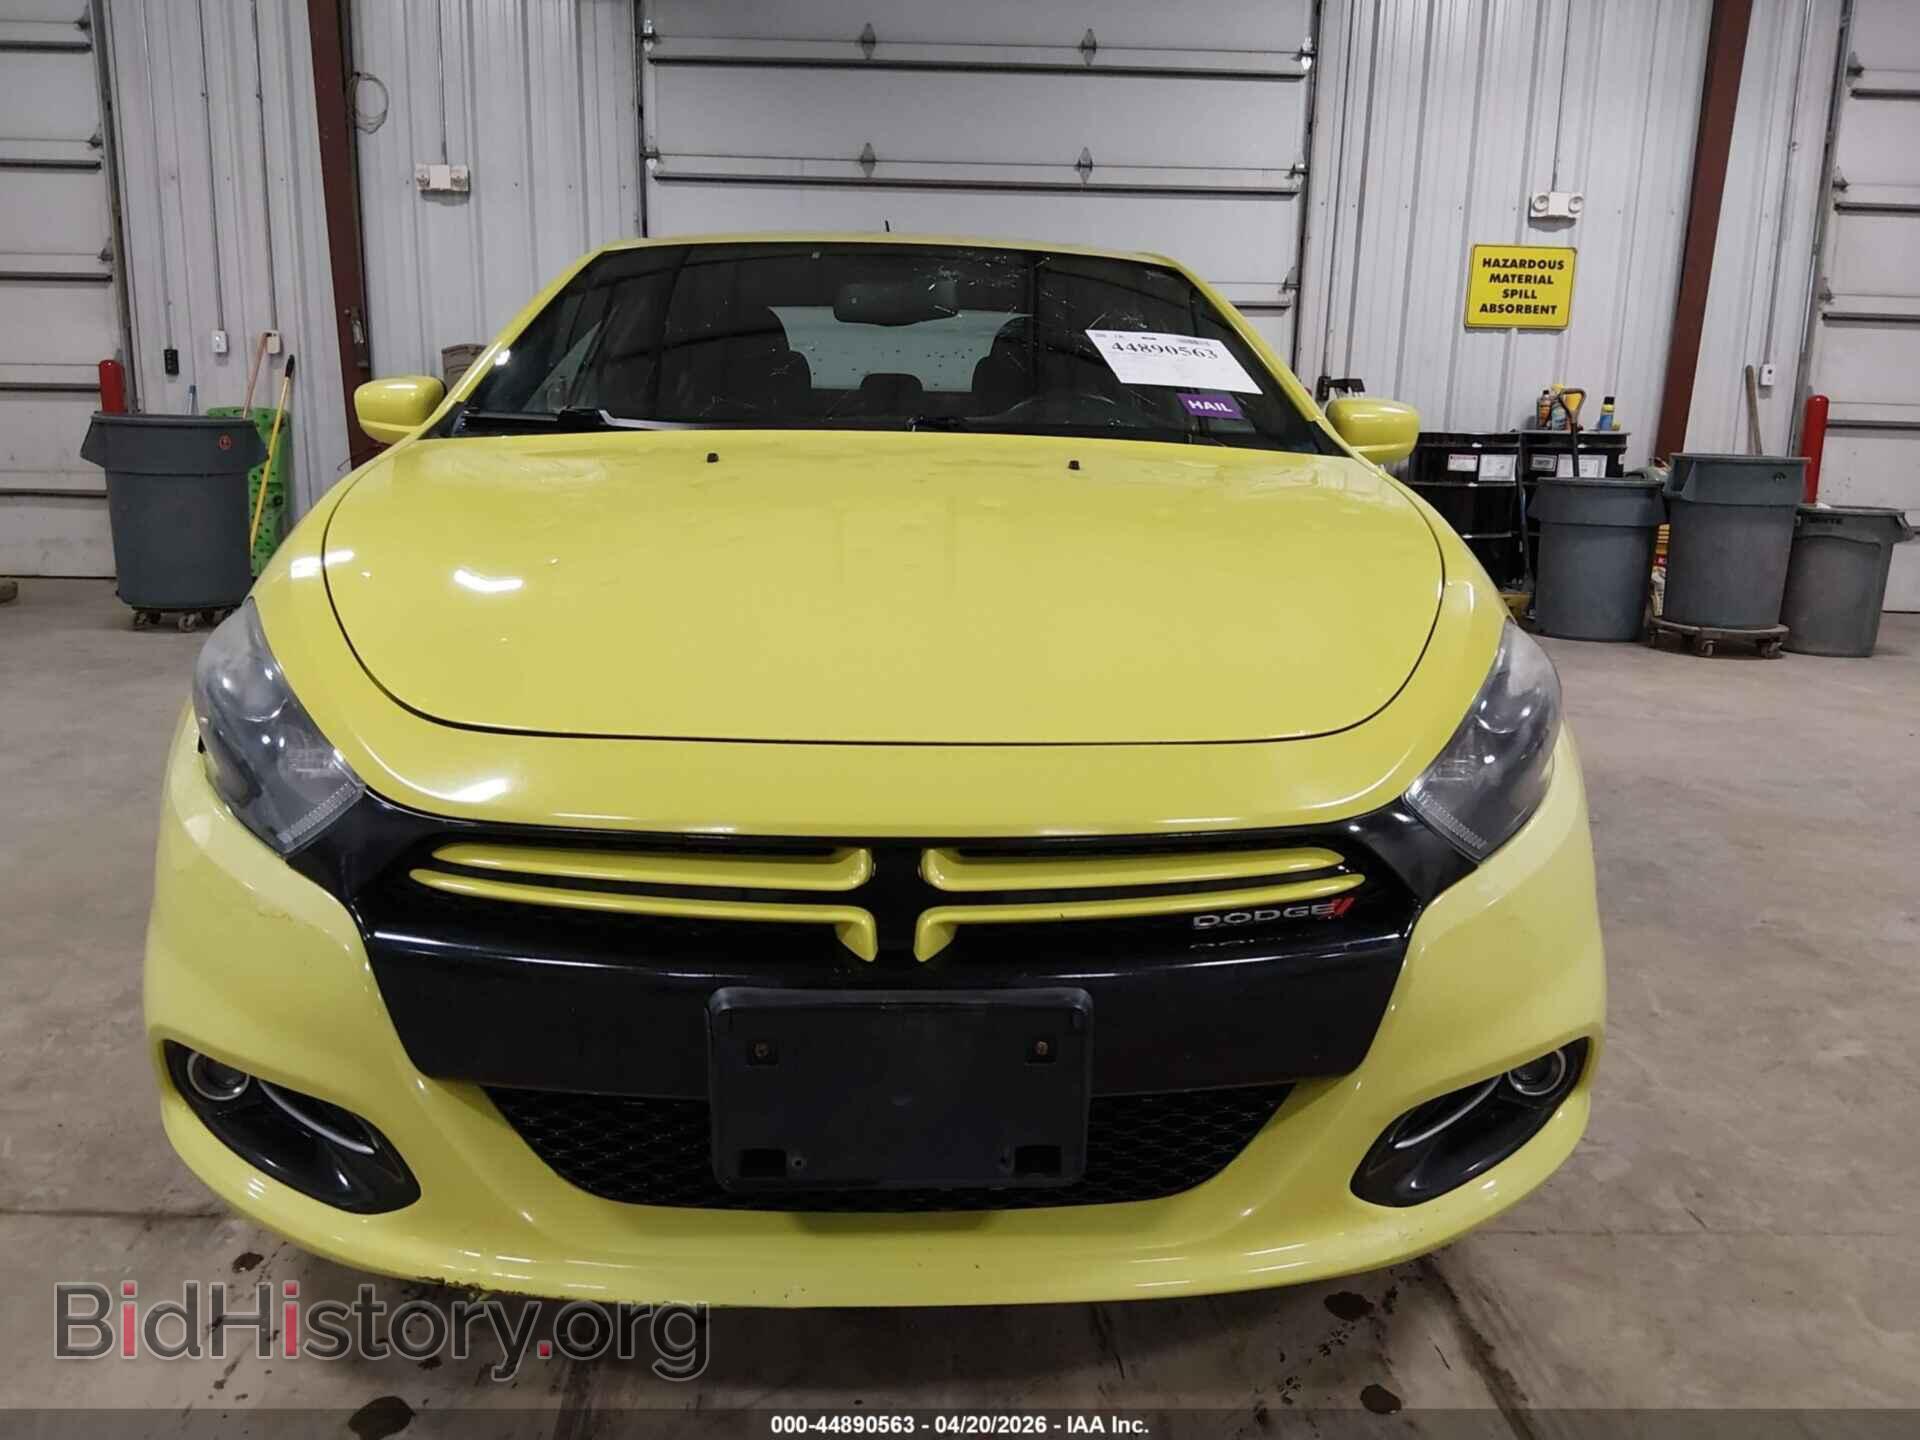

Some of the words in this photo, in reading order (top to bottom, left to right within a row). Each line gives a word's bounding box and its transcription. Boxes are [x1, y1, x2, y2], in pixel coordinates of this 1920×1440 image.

[1482, 258, 1565, 270] HAZARDOUS
[1489, 273, 1554, 285] MATERIAL
[1502, 289, 1537, 299] SPILL
[1479, 303, 1557, 314] ABSORBENT
[1111, 341, 1219, 360] 44890563
[1188, 399, 1233, 413] HAIL
[1193, 903, 1336, 928] DODGE
